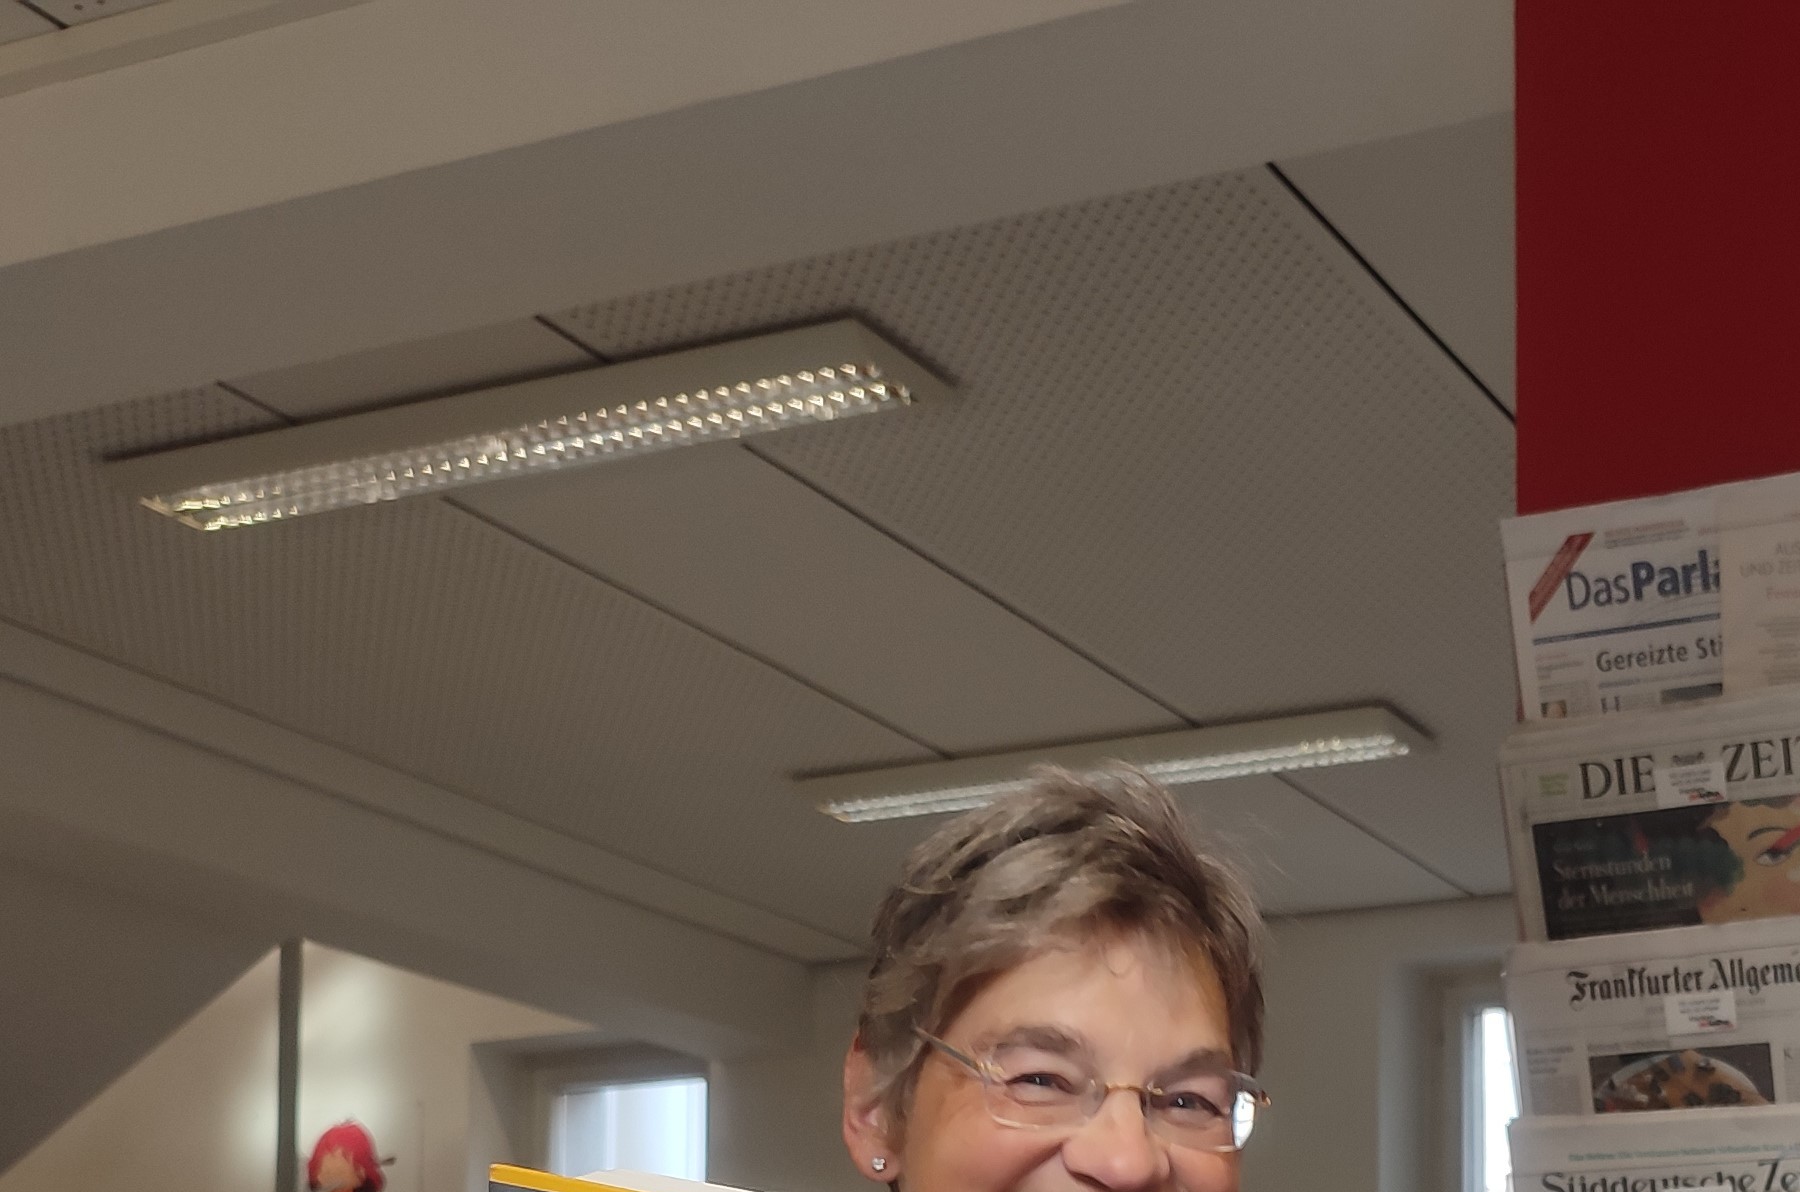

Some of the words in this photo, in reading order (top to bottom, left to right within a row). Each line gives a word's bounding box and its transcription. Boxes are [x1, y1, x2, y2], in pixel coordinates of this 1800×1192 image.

[1596, 642, 1689, 673] Gereizte
[1579, 754, 1656, 800] DIE
[1566, 966, 1703, 1011] Frankfurter
